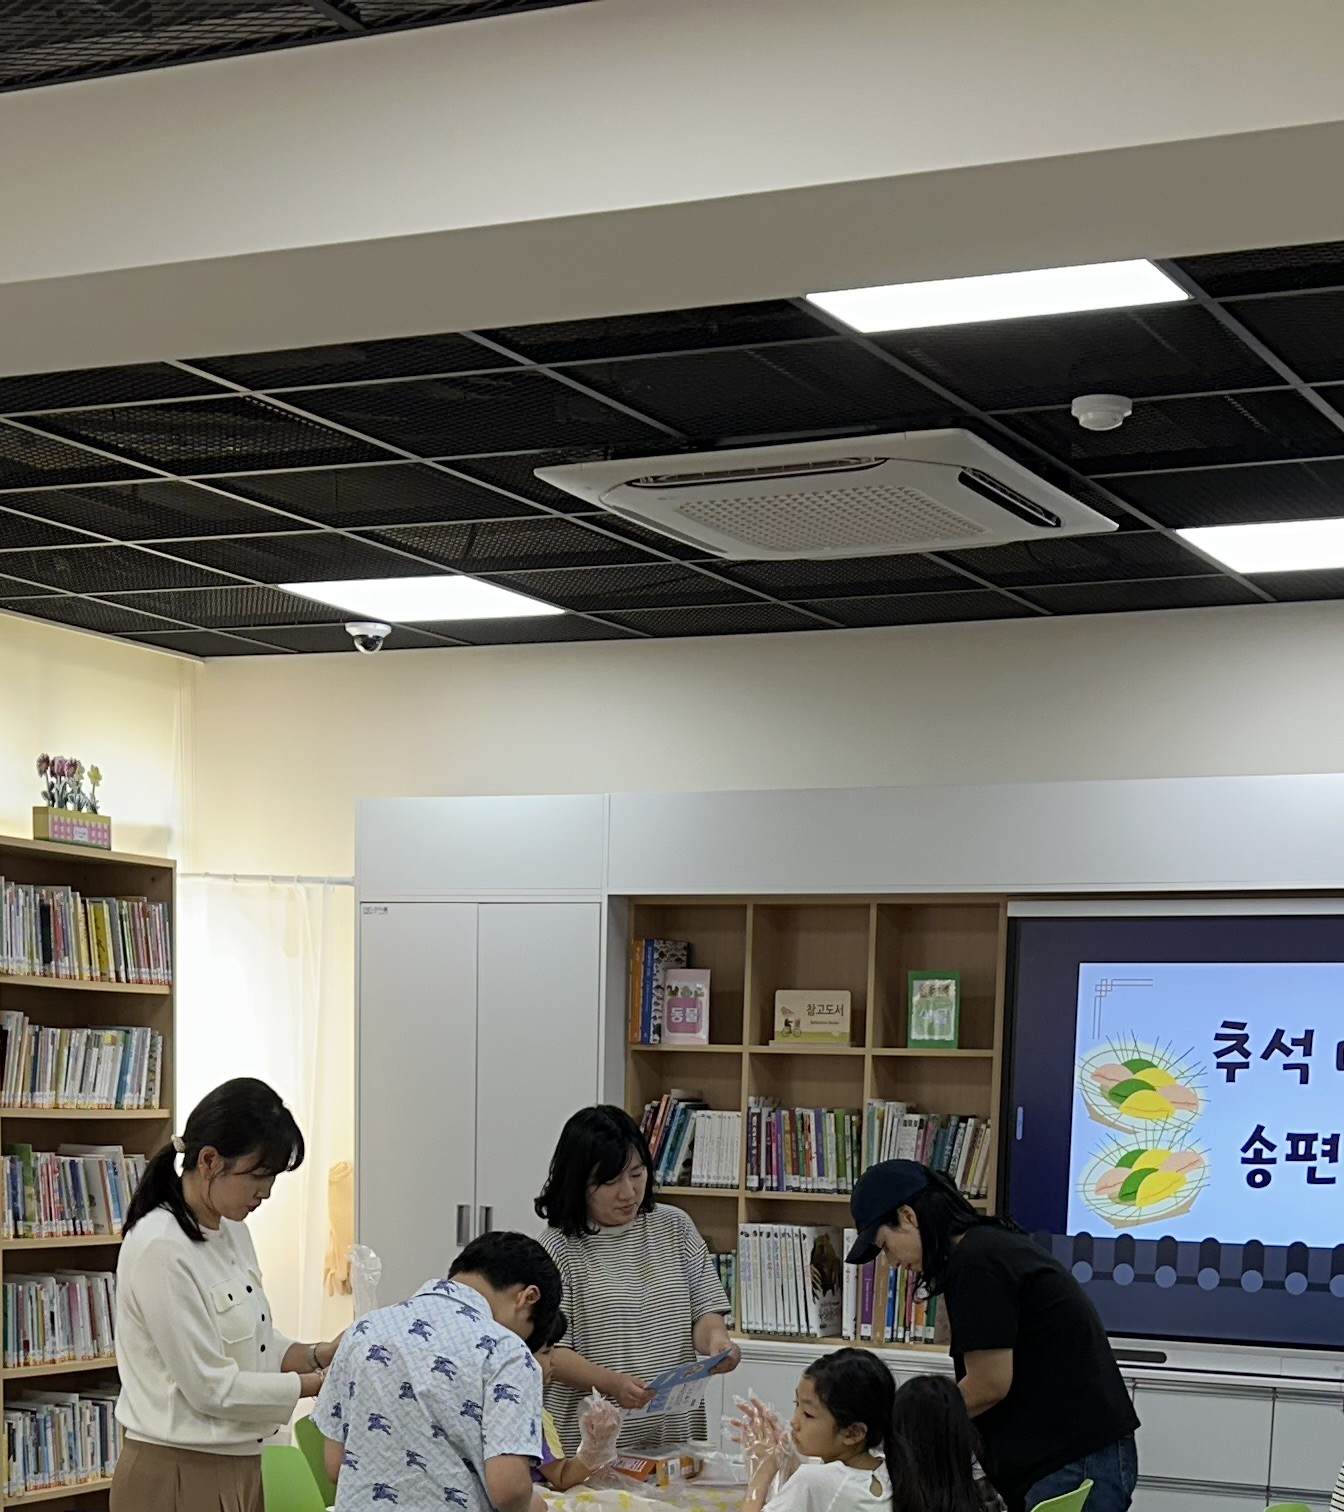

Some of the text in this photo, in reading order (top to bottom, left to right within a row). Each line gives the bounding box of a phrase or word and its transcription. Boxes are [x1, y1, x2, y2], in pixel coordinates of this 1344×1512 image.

[806, 1003, 844, 1017] 참고도서
[1212, 1020, 1315, 1086] 추석
[1239, 1124, 1340, 1189] 송편
